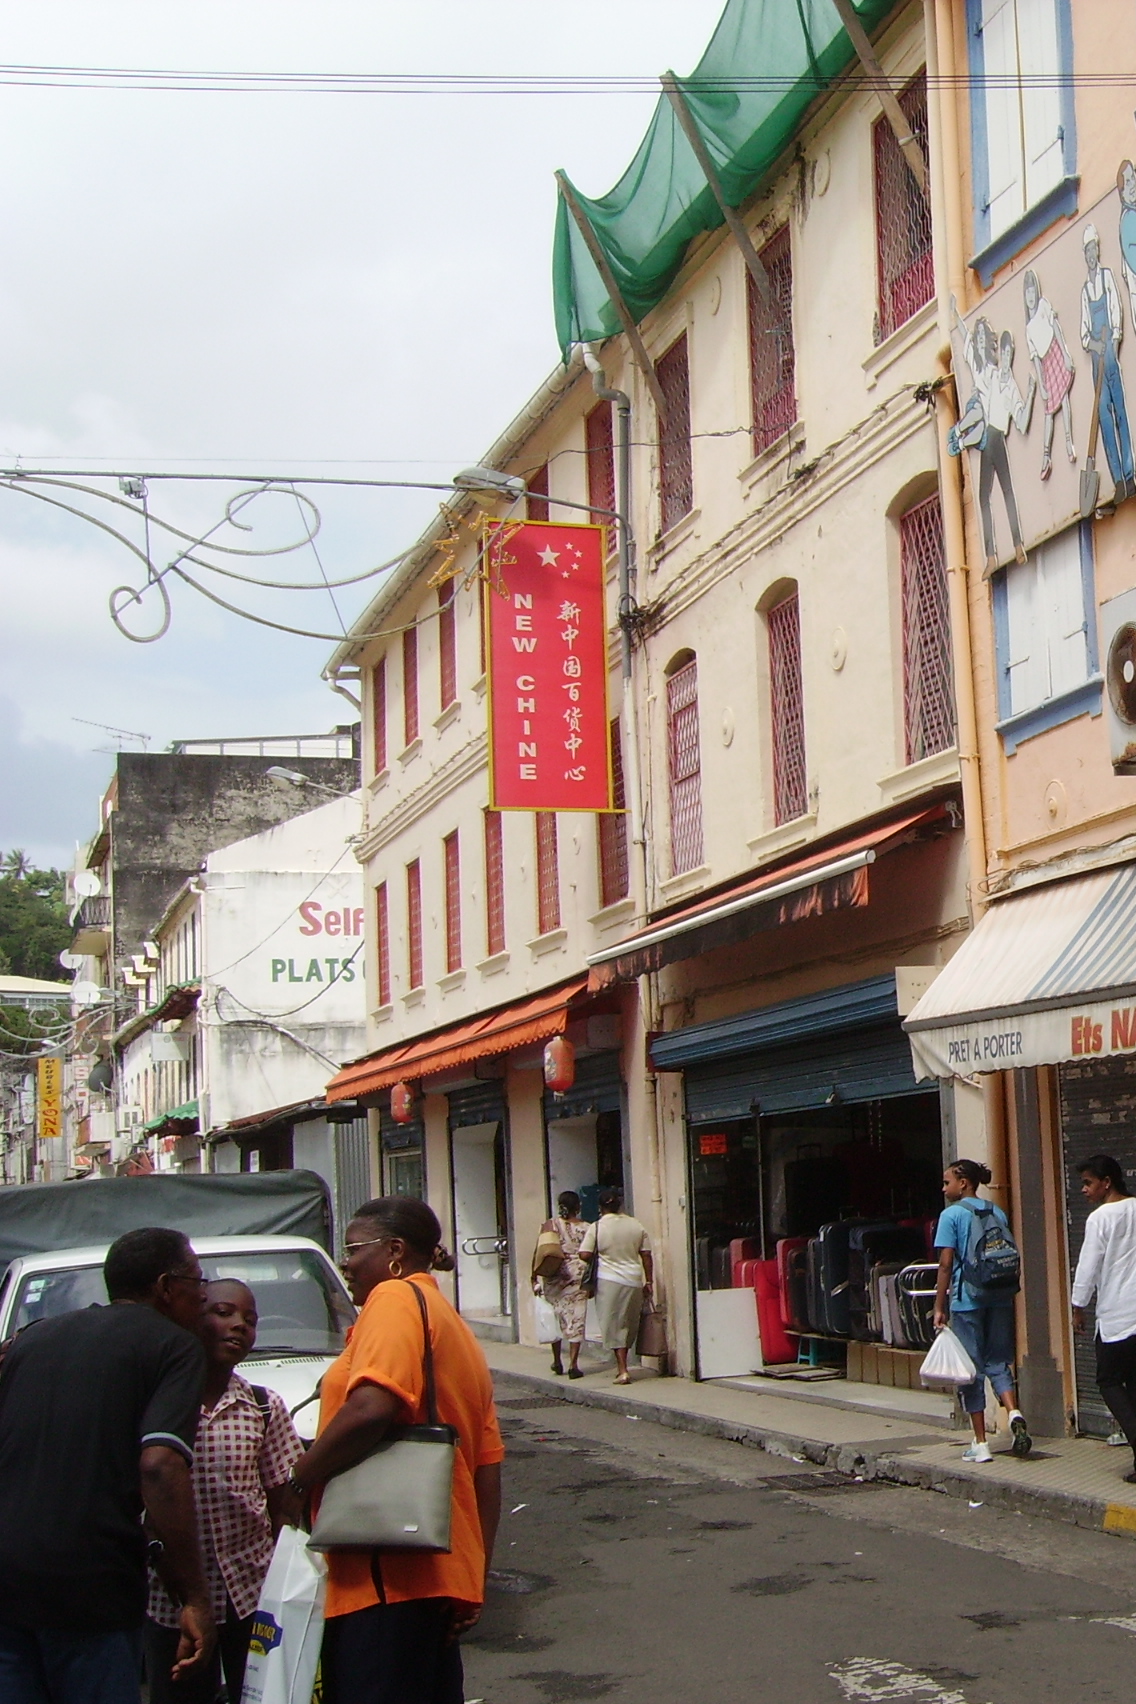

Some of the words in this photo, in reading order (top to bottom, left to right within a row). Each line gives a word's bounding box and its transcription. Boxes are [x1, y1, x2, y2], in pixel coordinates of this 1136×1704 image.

[512, 593, 537, 653] NEW
[556, 599, 587, 782] 新中国百货中心
[516, 675, 538, 780] CHINE
[298, 901, 364, 936] Self
[271, 958, 355, 983] PLATS
[948, 1039, 971, 1064] PRET
[973, 1038, 982, 1060] A
[983, 1031, 1023, 1059] PORTER
[1070, 1015, 1103, 1056] Ets
[42, 1099, 58, 1135] YONA
